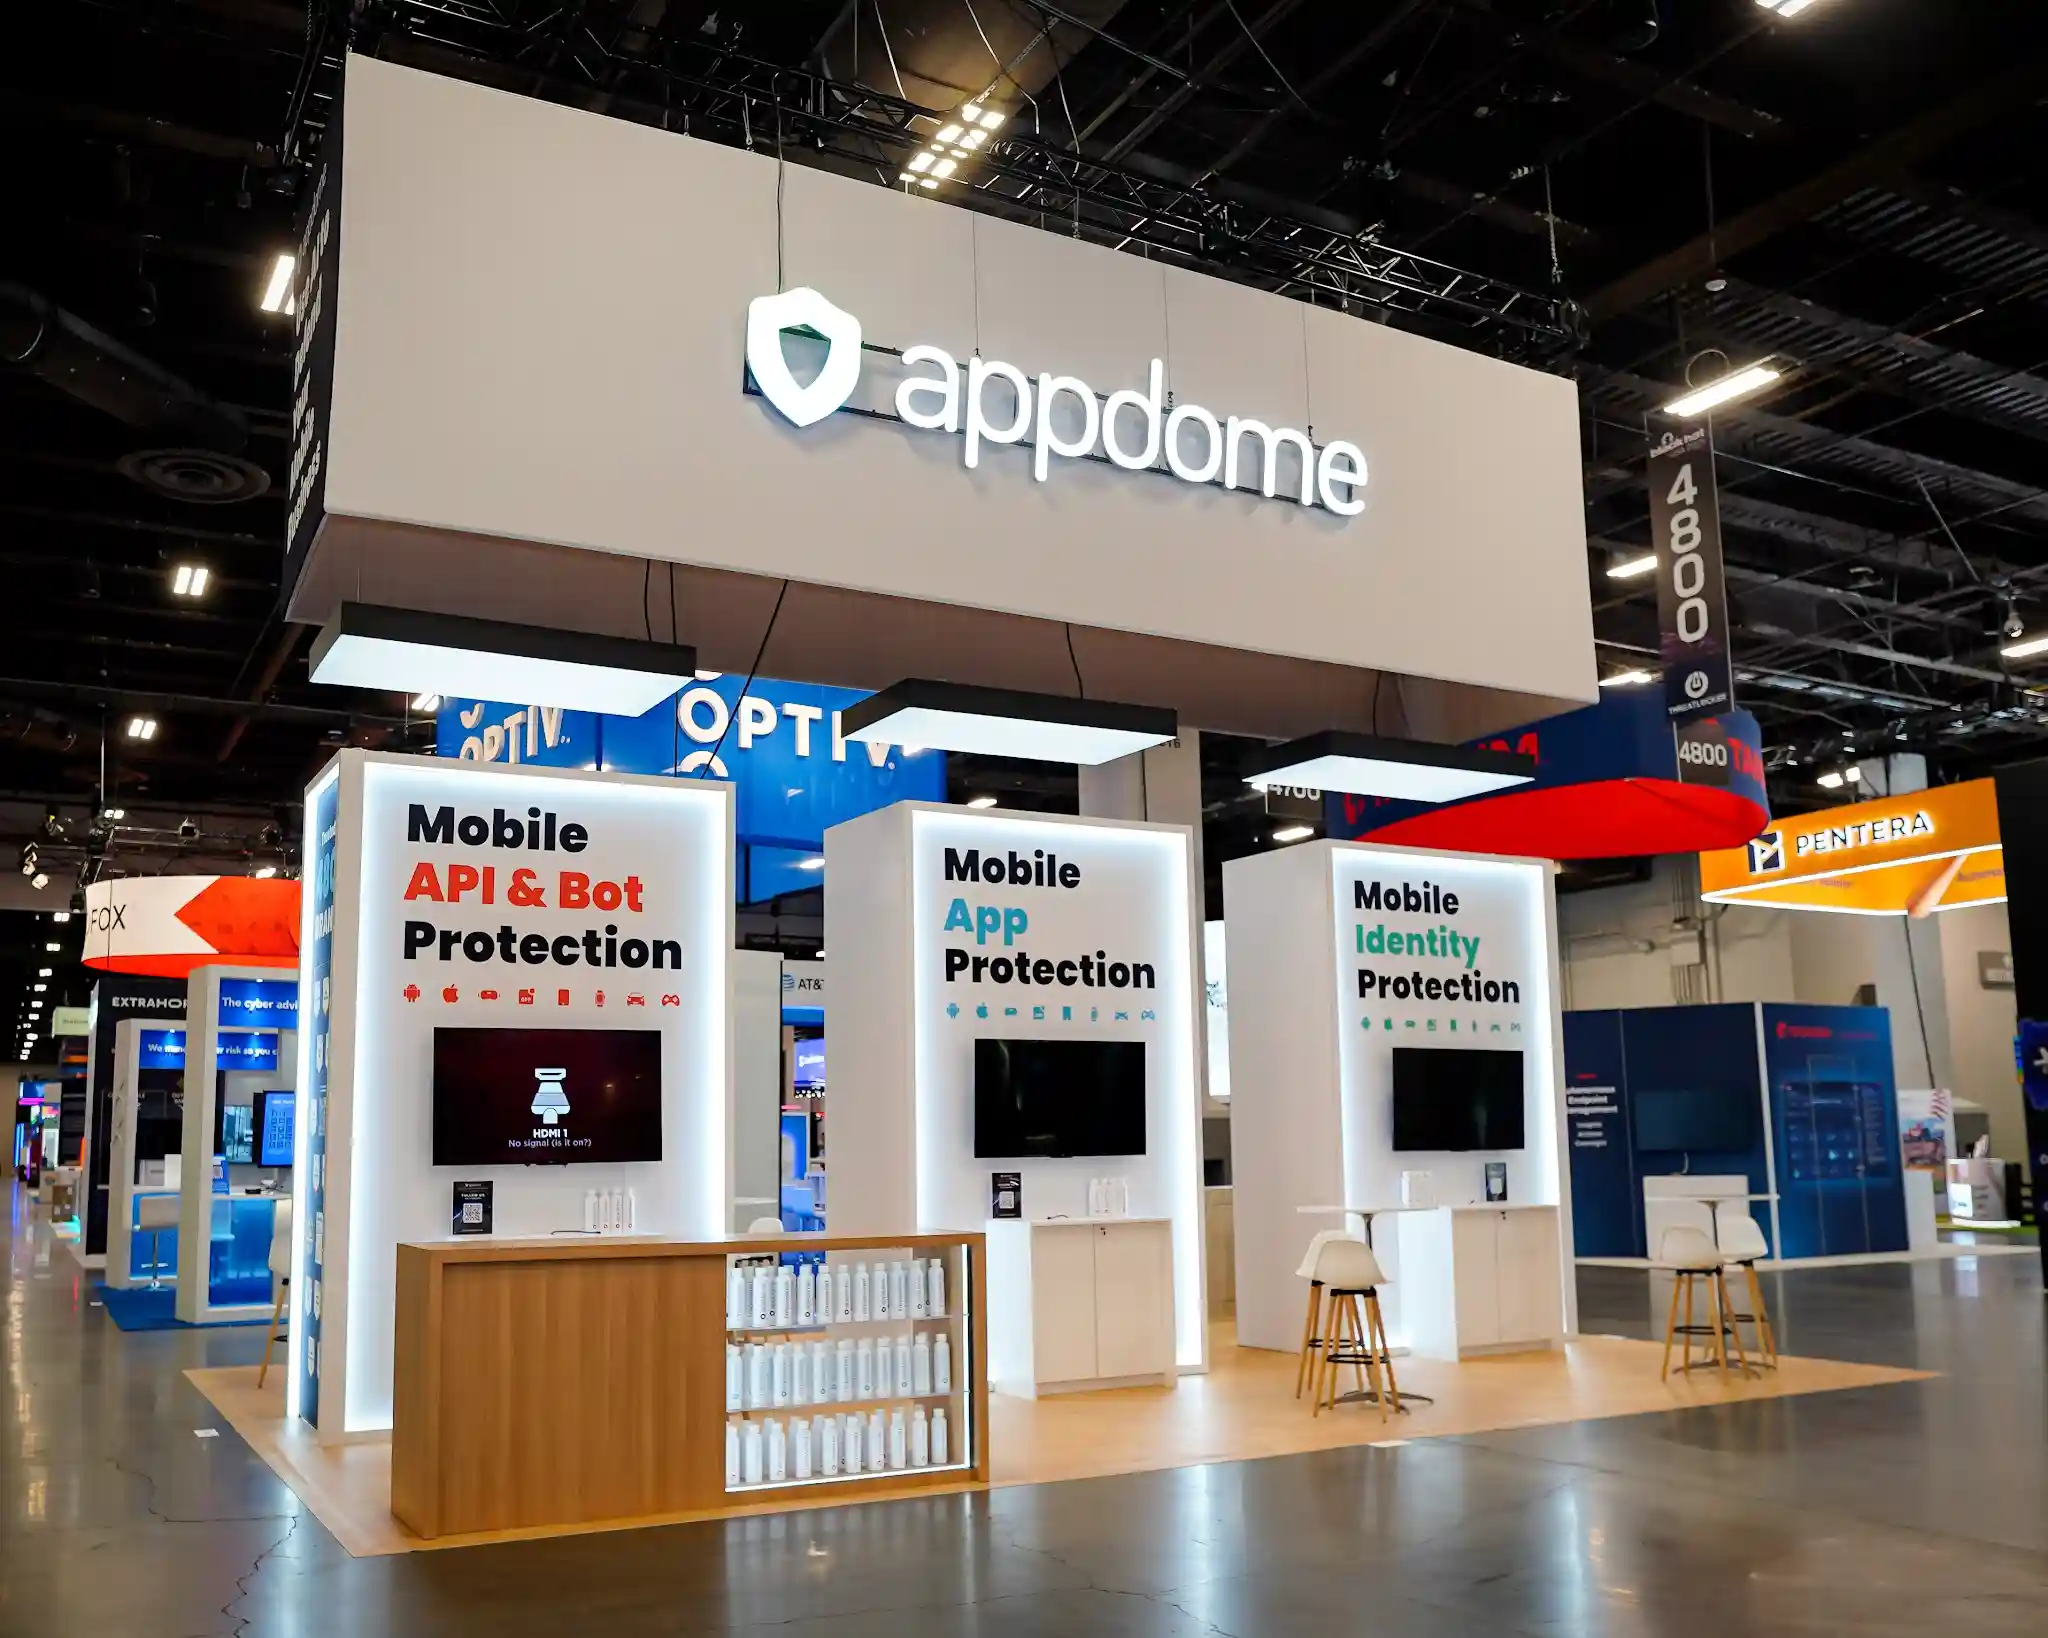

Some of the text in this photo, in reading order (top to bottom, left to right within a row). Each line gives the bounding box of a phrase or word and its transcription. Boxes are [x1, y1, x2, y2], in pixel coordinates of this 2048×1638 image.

[895, 344, 1369, 516] appdome
[1666, 463, 1709, 643] 4800
[1680, 740, 1728, 767] 4800
[407, 803, 588, 853] Mobile
[1796, 811, 1935, 857] PENTERA
[403, 862, 643, 912] API & Bot
[944, 847, 1081, 889] Mobile
[1354, 880, 1460, 915] Mobile
[87, 904, 127, 934] FOX
[943, 898, 1029, 946] App
[403, 920, 682, 970] Protection
[1355, 924, 1481, 969] Identity
[799, 978, 825, 991] AT&
[945, 948, 1156, 989] Protection
[1358, 969, 1520, 1003] Protection
[222, 997, 241, 1008] The
[244, 997, 273, 1012] cyber
[508, 1138, 592, 1149] No signal (is it on?)
[533, 1128, 568, 1139] HDMI 1
